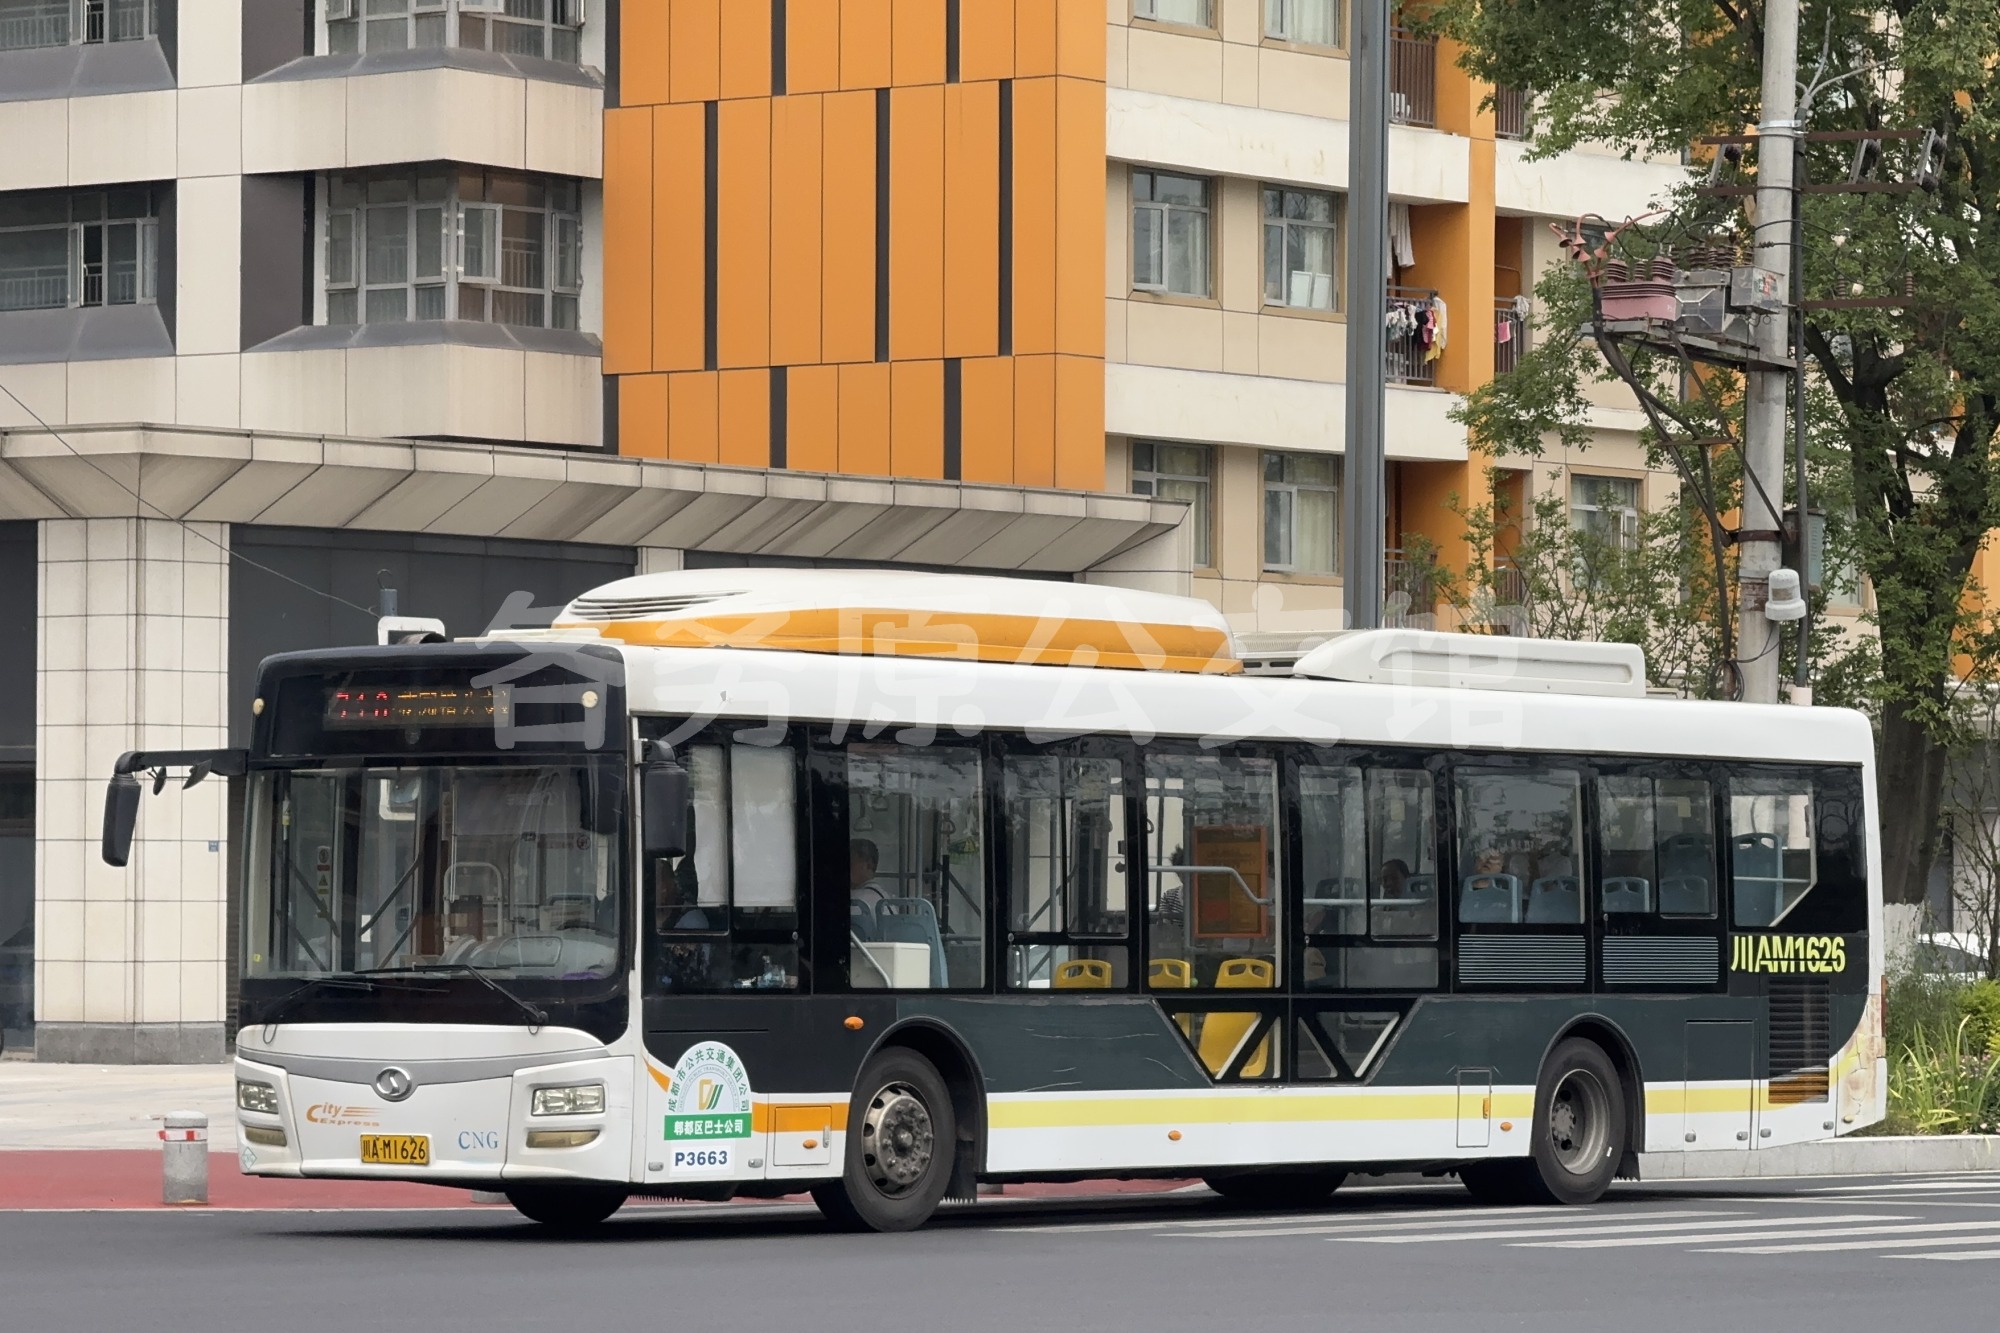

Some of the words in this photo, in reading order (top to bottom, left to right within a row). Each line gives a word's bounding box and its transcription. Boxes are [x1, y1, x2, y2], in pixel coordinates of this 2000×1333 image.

[1731, 935, 1846, 973] 川AM1626
[668, 1047, 750, 1112] 成都市公共交通集团公司
[306, 1102, 342, 1122] City
[319, 1118, 380, 1127] Express
[674, 1119, 744, 1135] 郫都区巴士公司
[458, 1130, 499, 1150] CNG
[675, 1150, 728, 1167] P3663
